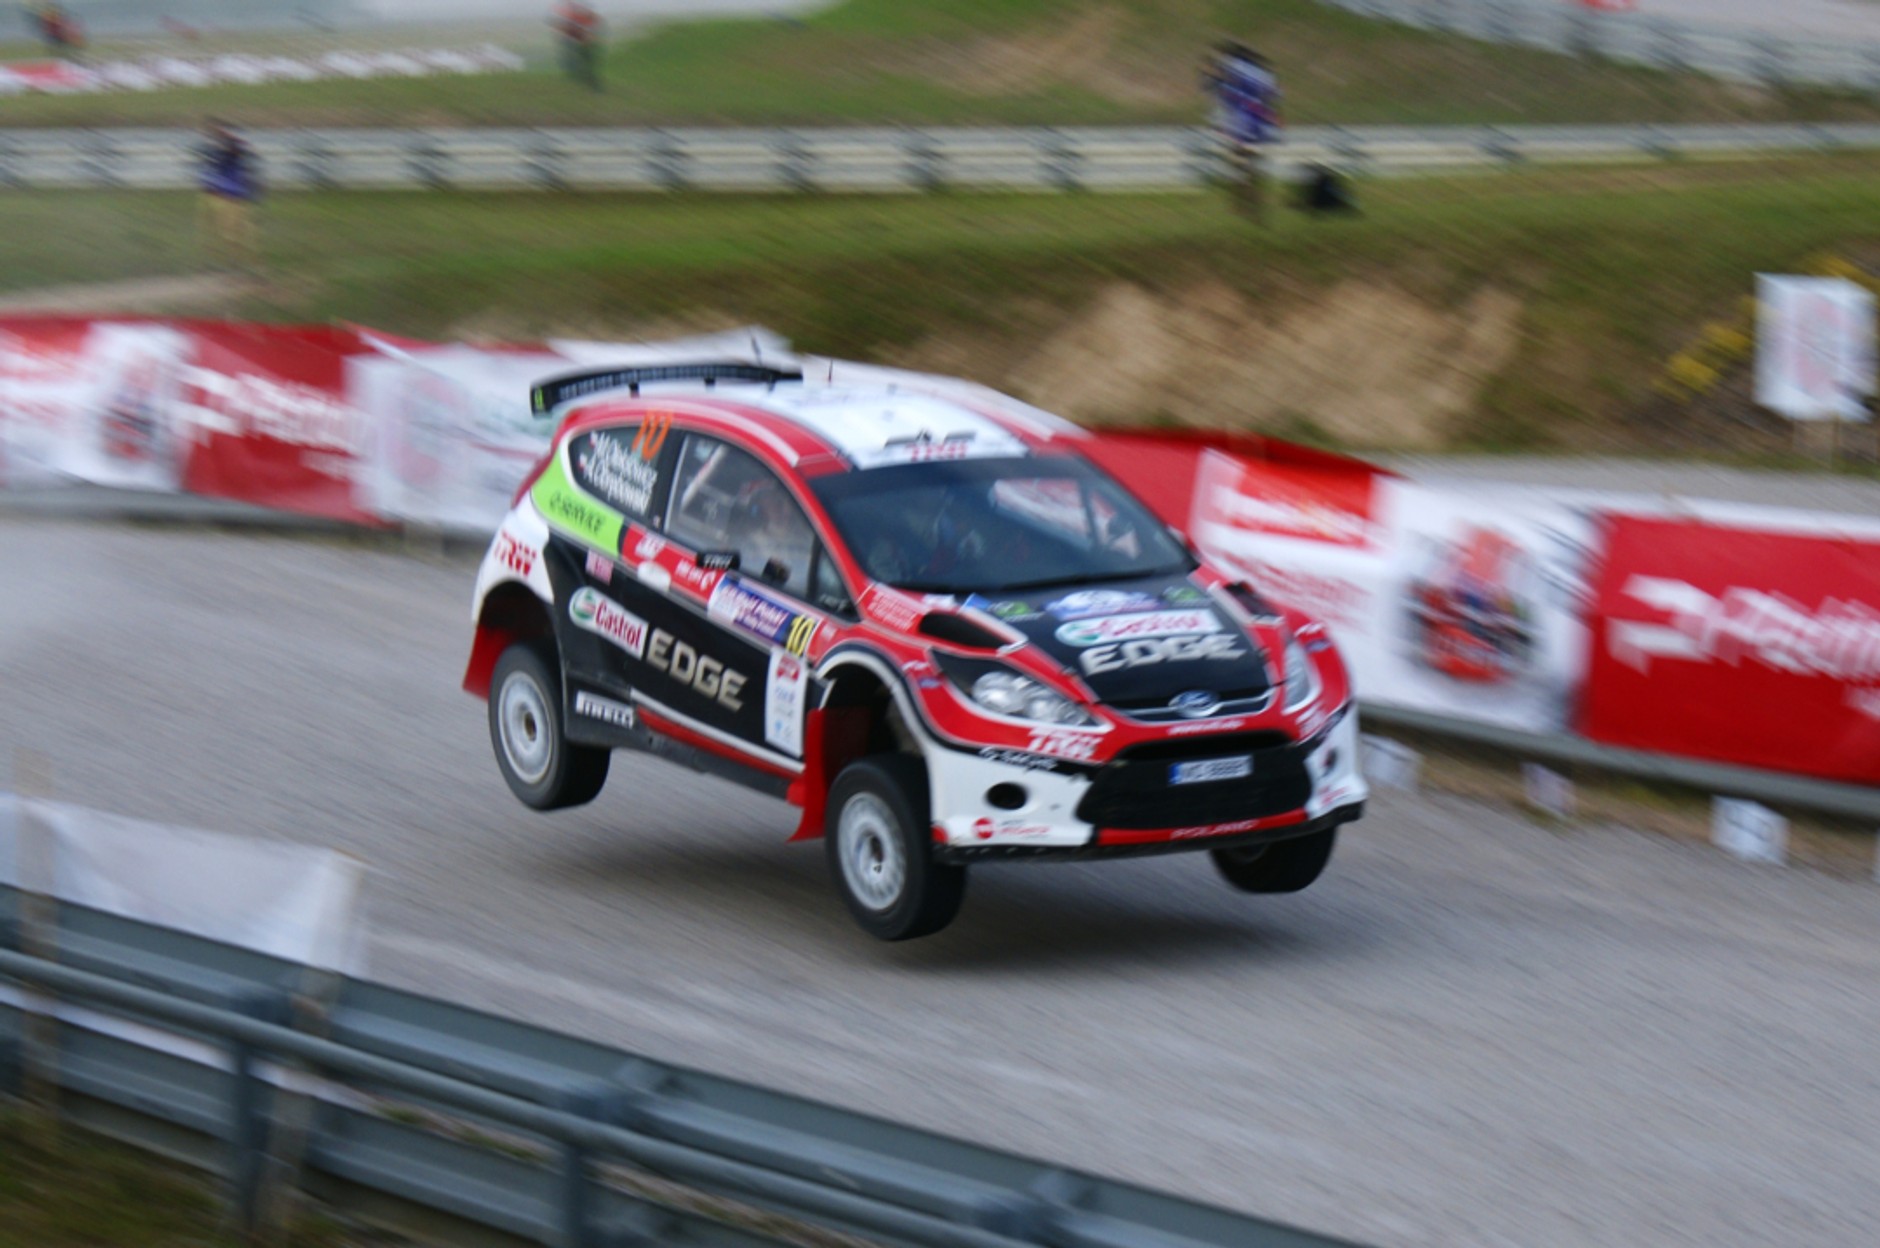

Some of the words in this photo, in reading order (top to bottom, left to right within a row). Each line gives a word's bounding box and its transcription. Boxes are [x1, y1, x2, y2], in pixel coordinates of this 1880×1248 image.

[632, 410, 672, 463] 10
[494, 529, 537, 577] TRW
[595, 600, 643, 650] Castrol
[785, 614, 817, 657] 10
[646, 627, 750, 713] EDGE
[1078, 633, 1247, 676] EDGE
[576, 690, 634, 729] PIRELLI
[1026, 728, 1103, 763] TRW
